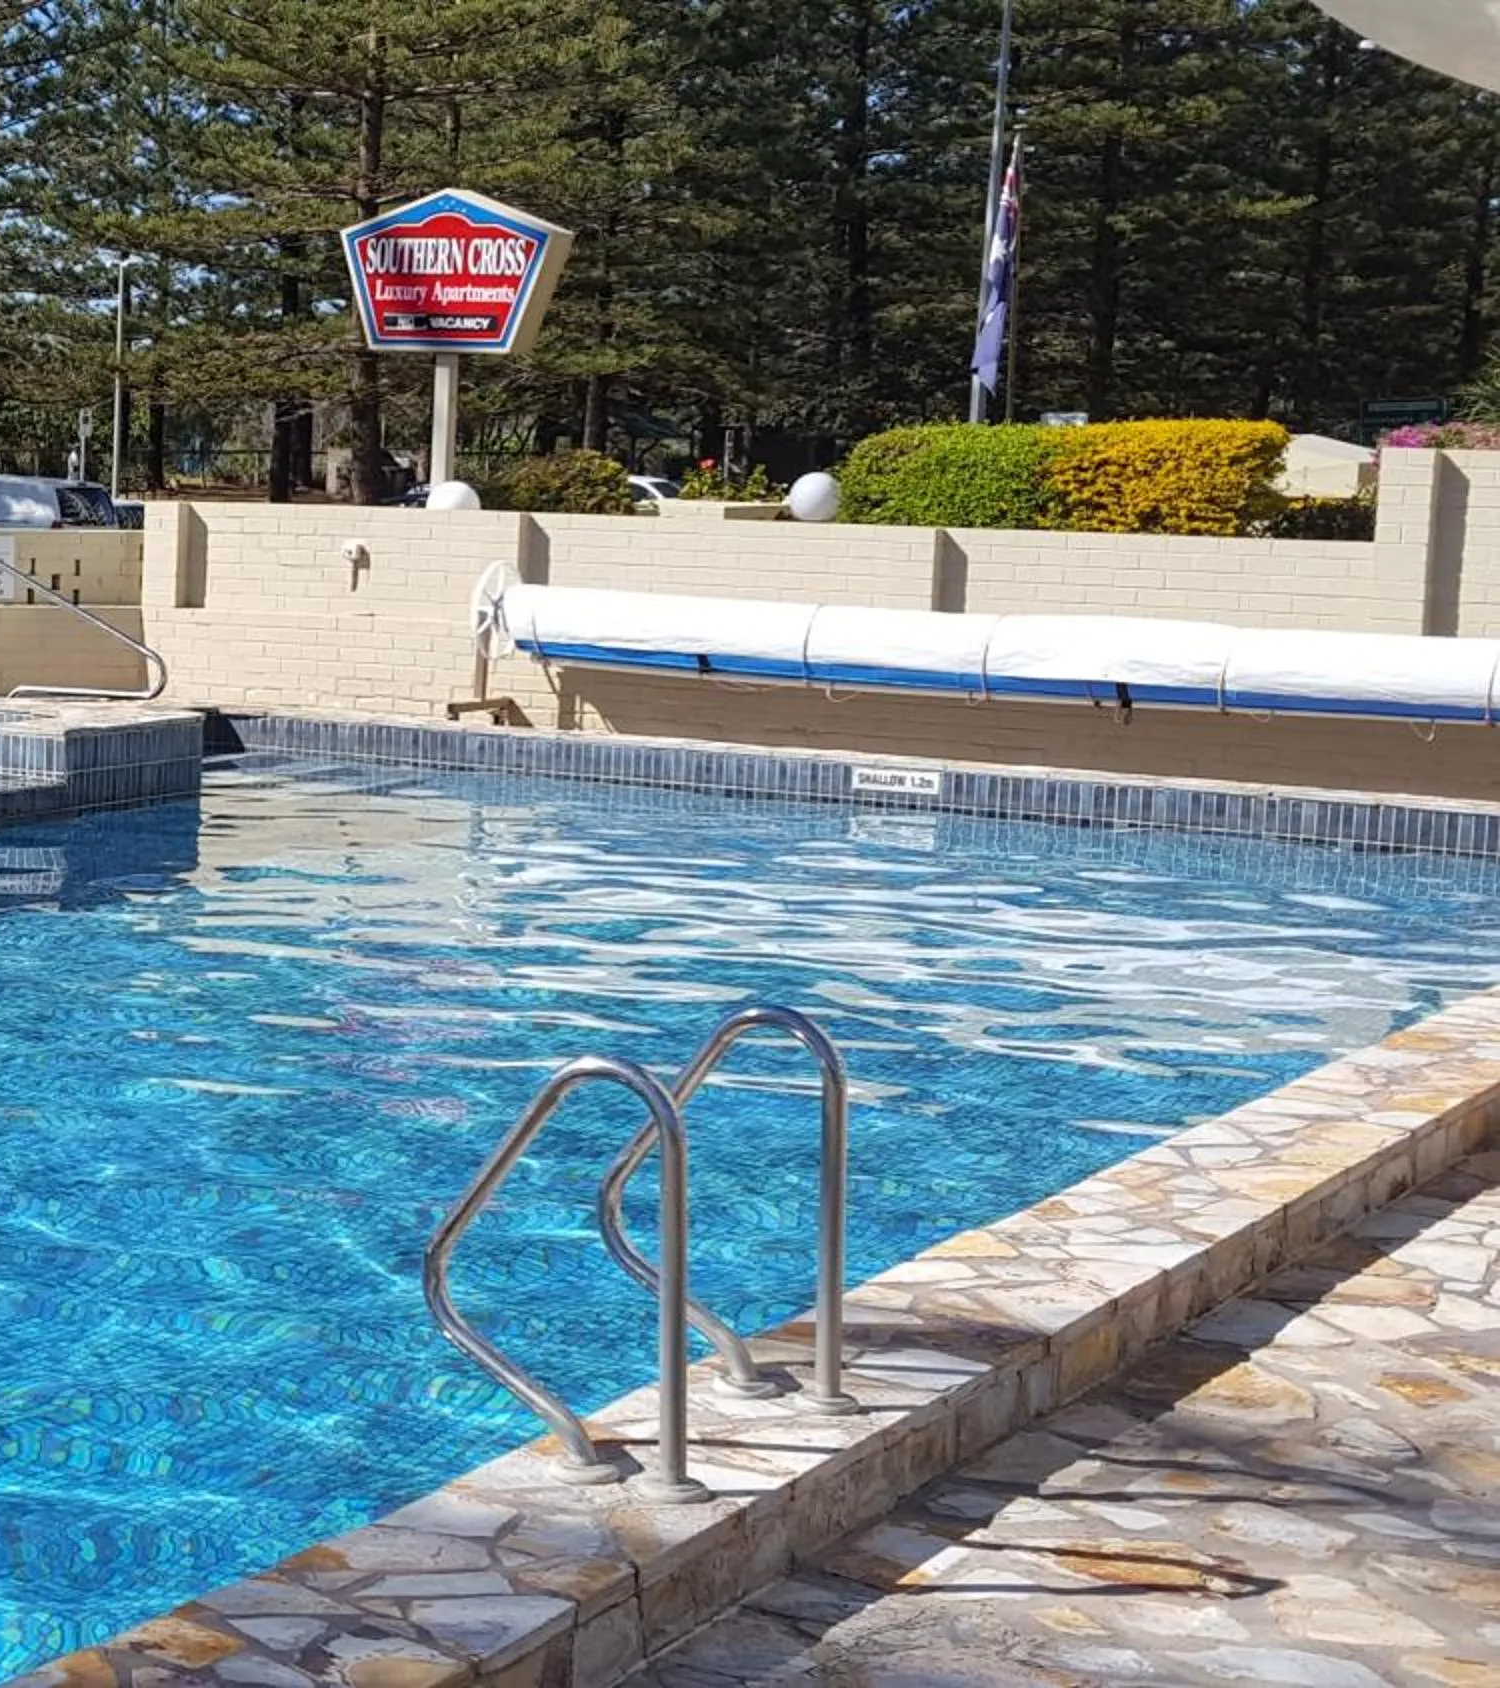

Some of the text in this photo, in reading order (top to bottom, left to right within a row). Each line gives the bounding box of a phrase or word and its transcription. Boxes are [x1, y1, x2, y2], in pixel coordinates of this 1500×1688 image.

[365, 237, 526, 276] SOUTHERN CROSS
[375, 279, 516, 306] Luxury Apartments
[428, 317, 492, 330] VACANCY
[858, 771, 906, 787] SHALLOW
